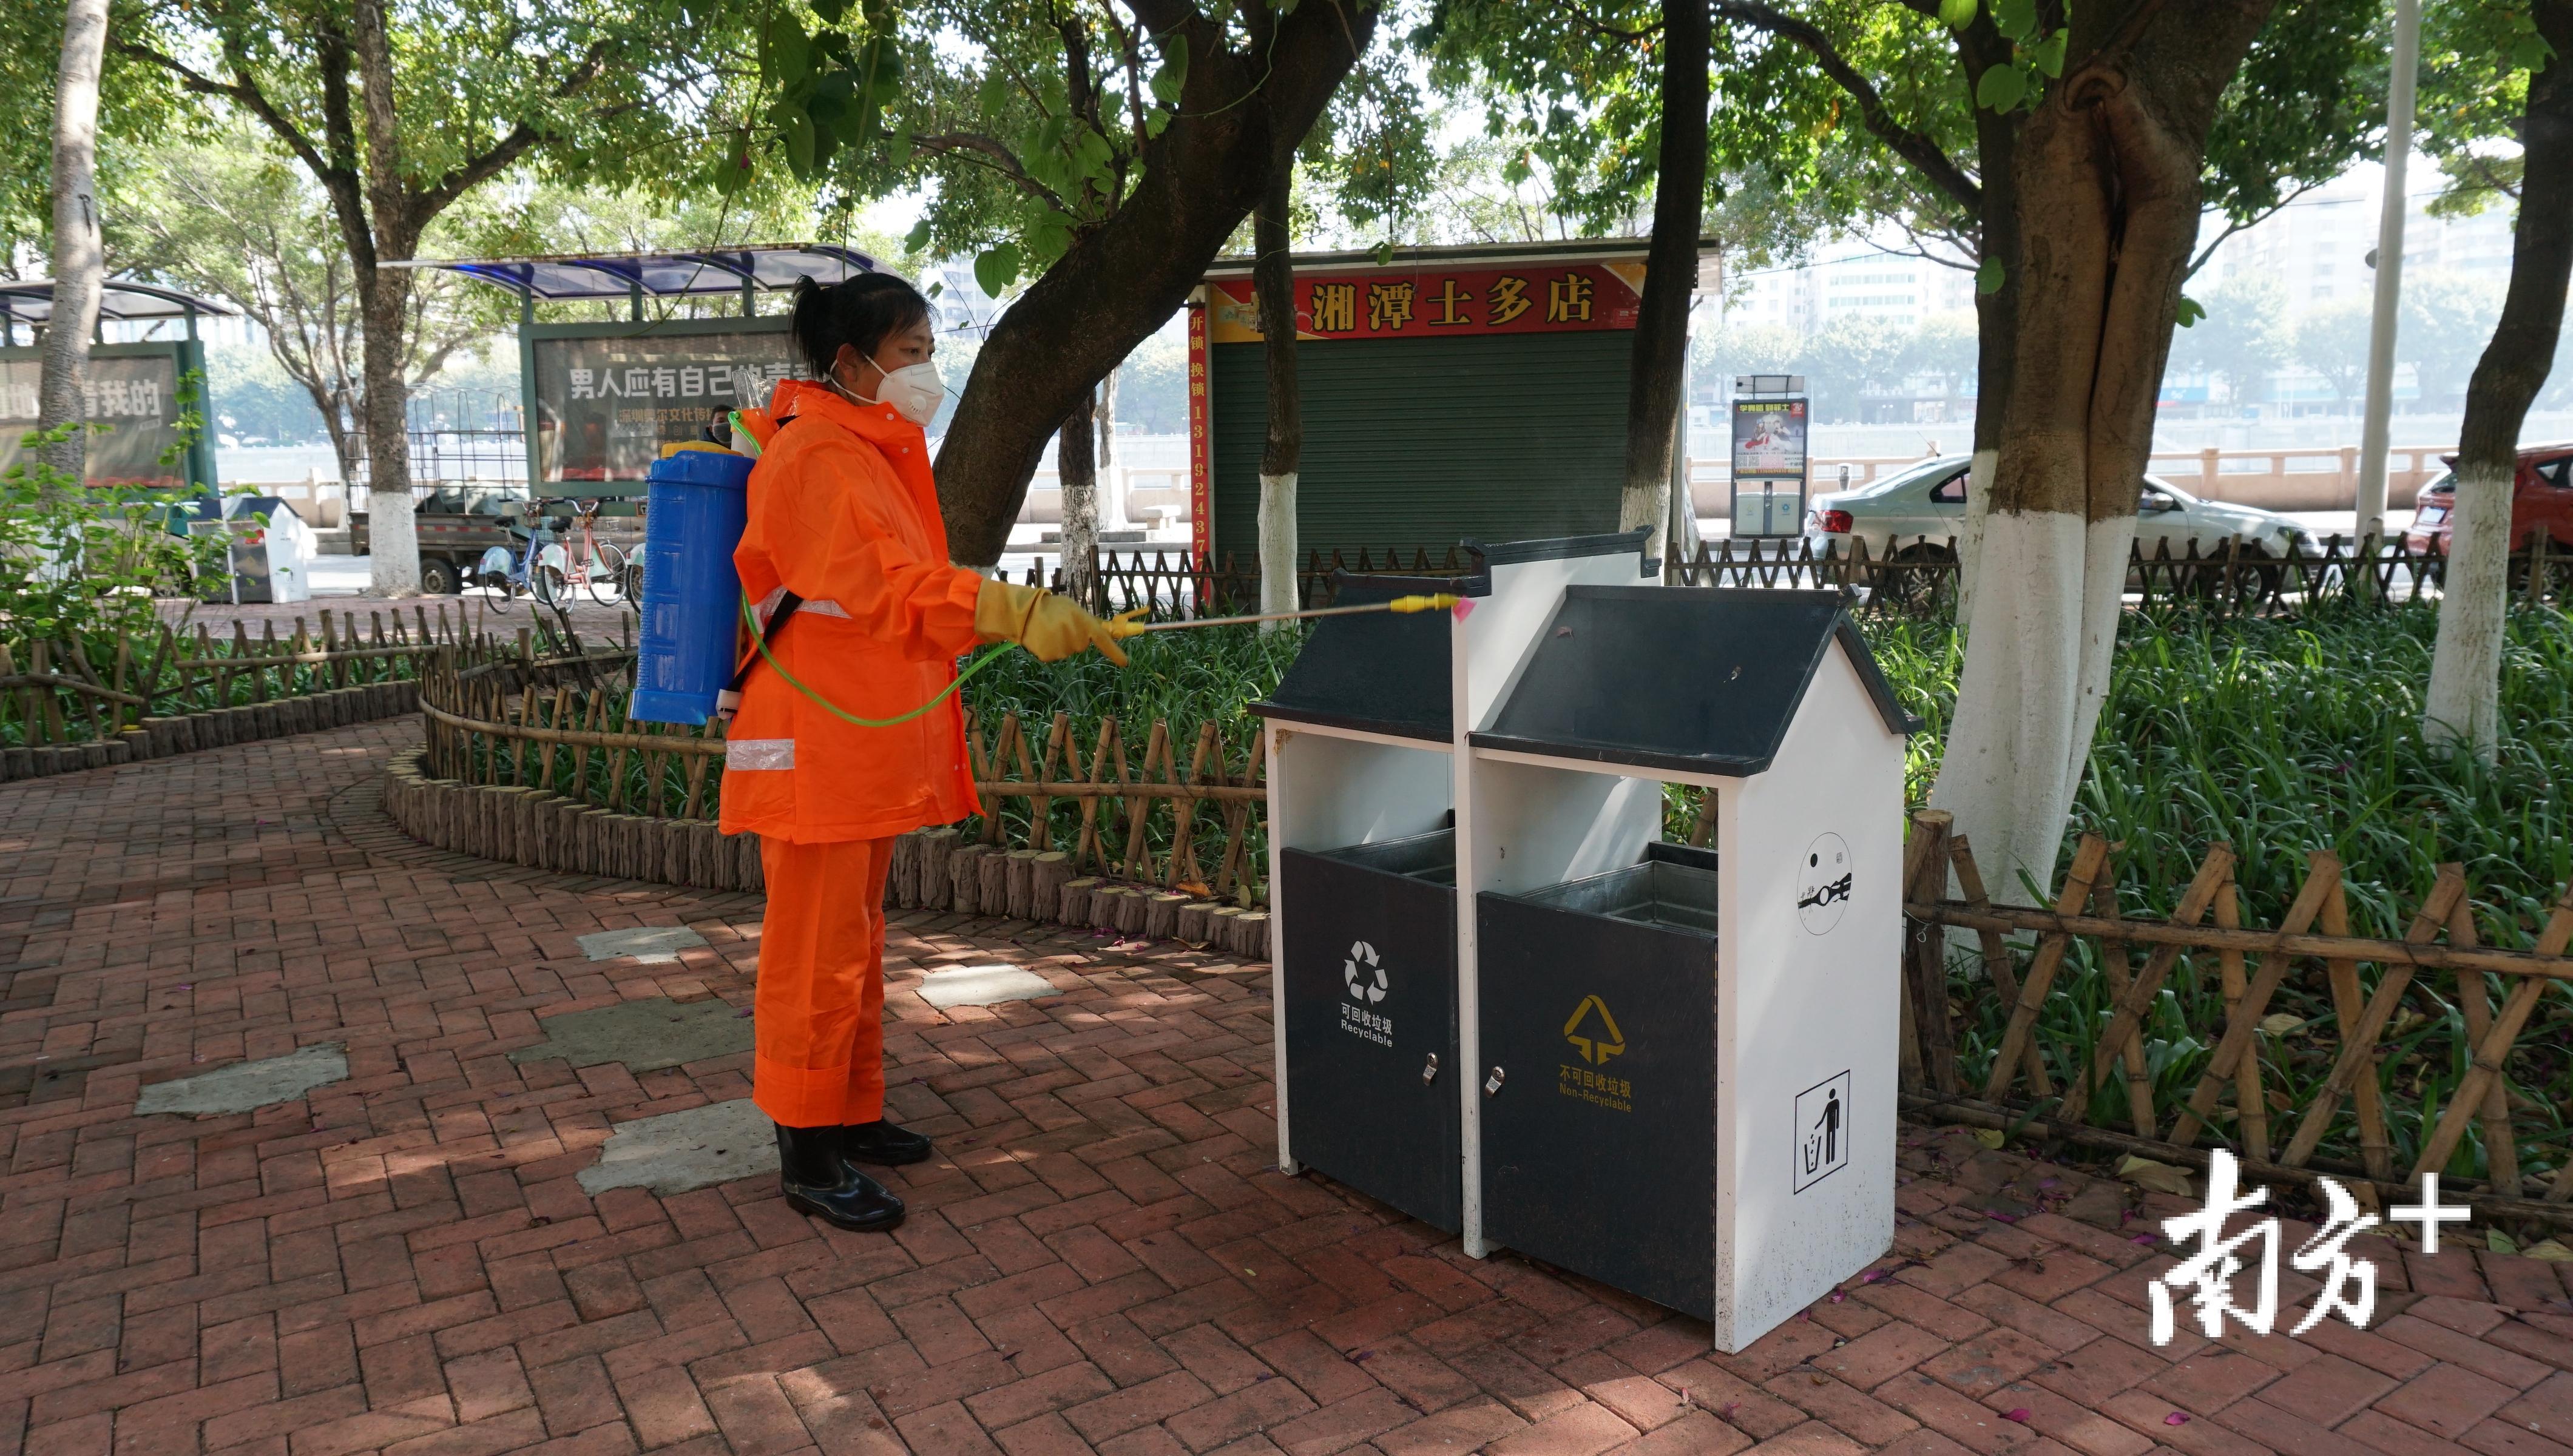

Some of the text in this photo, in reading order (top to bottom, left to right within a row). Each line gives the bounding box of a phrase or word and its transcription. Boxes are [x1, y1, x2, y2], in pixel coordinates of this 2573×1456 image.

[1311, 274, 1594, 331] 湘潭士多店
[1190, 316, 1204, 350] 开锁
[1191, 363, 1205, 397] 换锁
[1341, 1002, 1392, 1036] 可回收垃圾
[1341, 1019, 1393, 1047] Recyclable
[1560, 1064, 1631, 1099] 不可回收垃圾
[1560, 1083, 1632, 1113] Non-Recyclable
